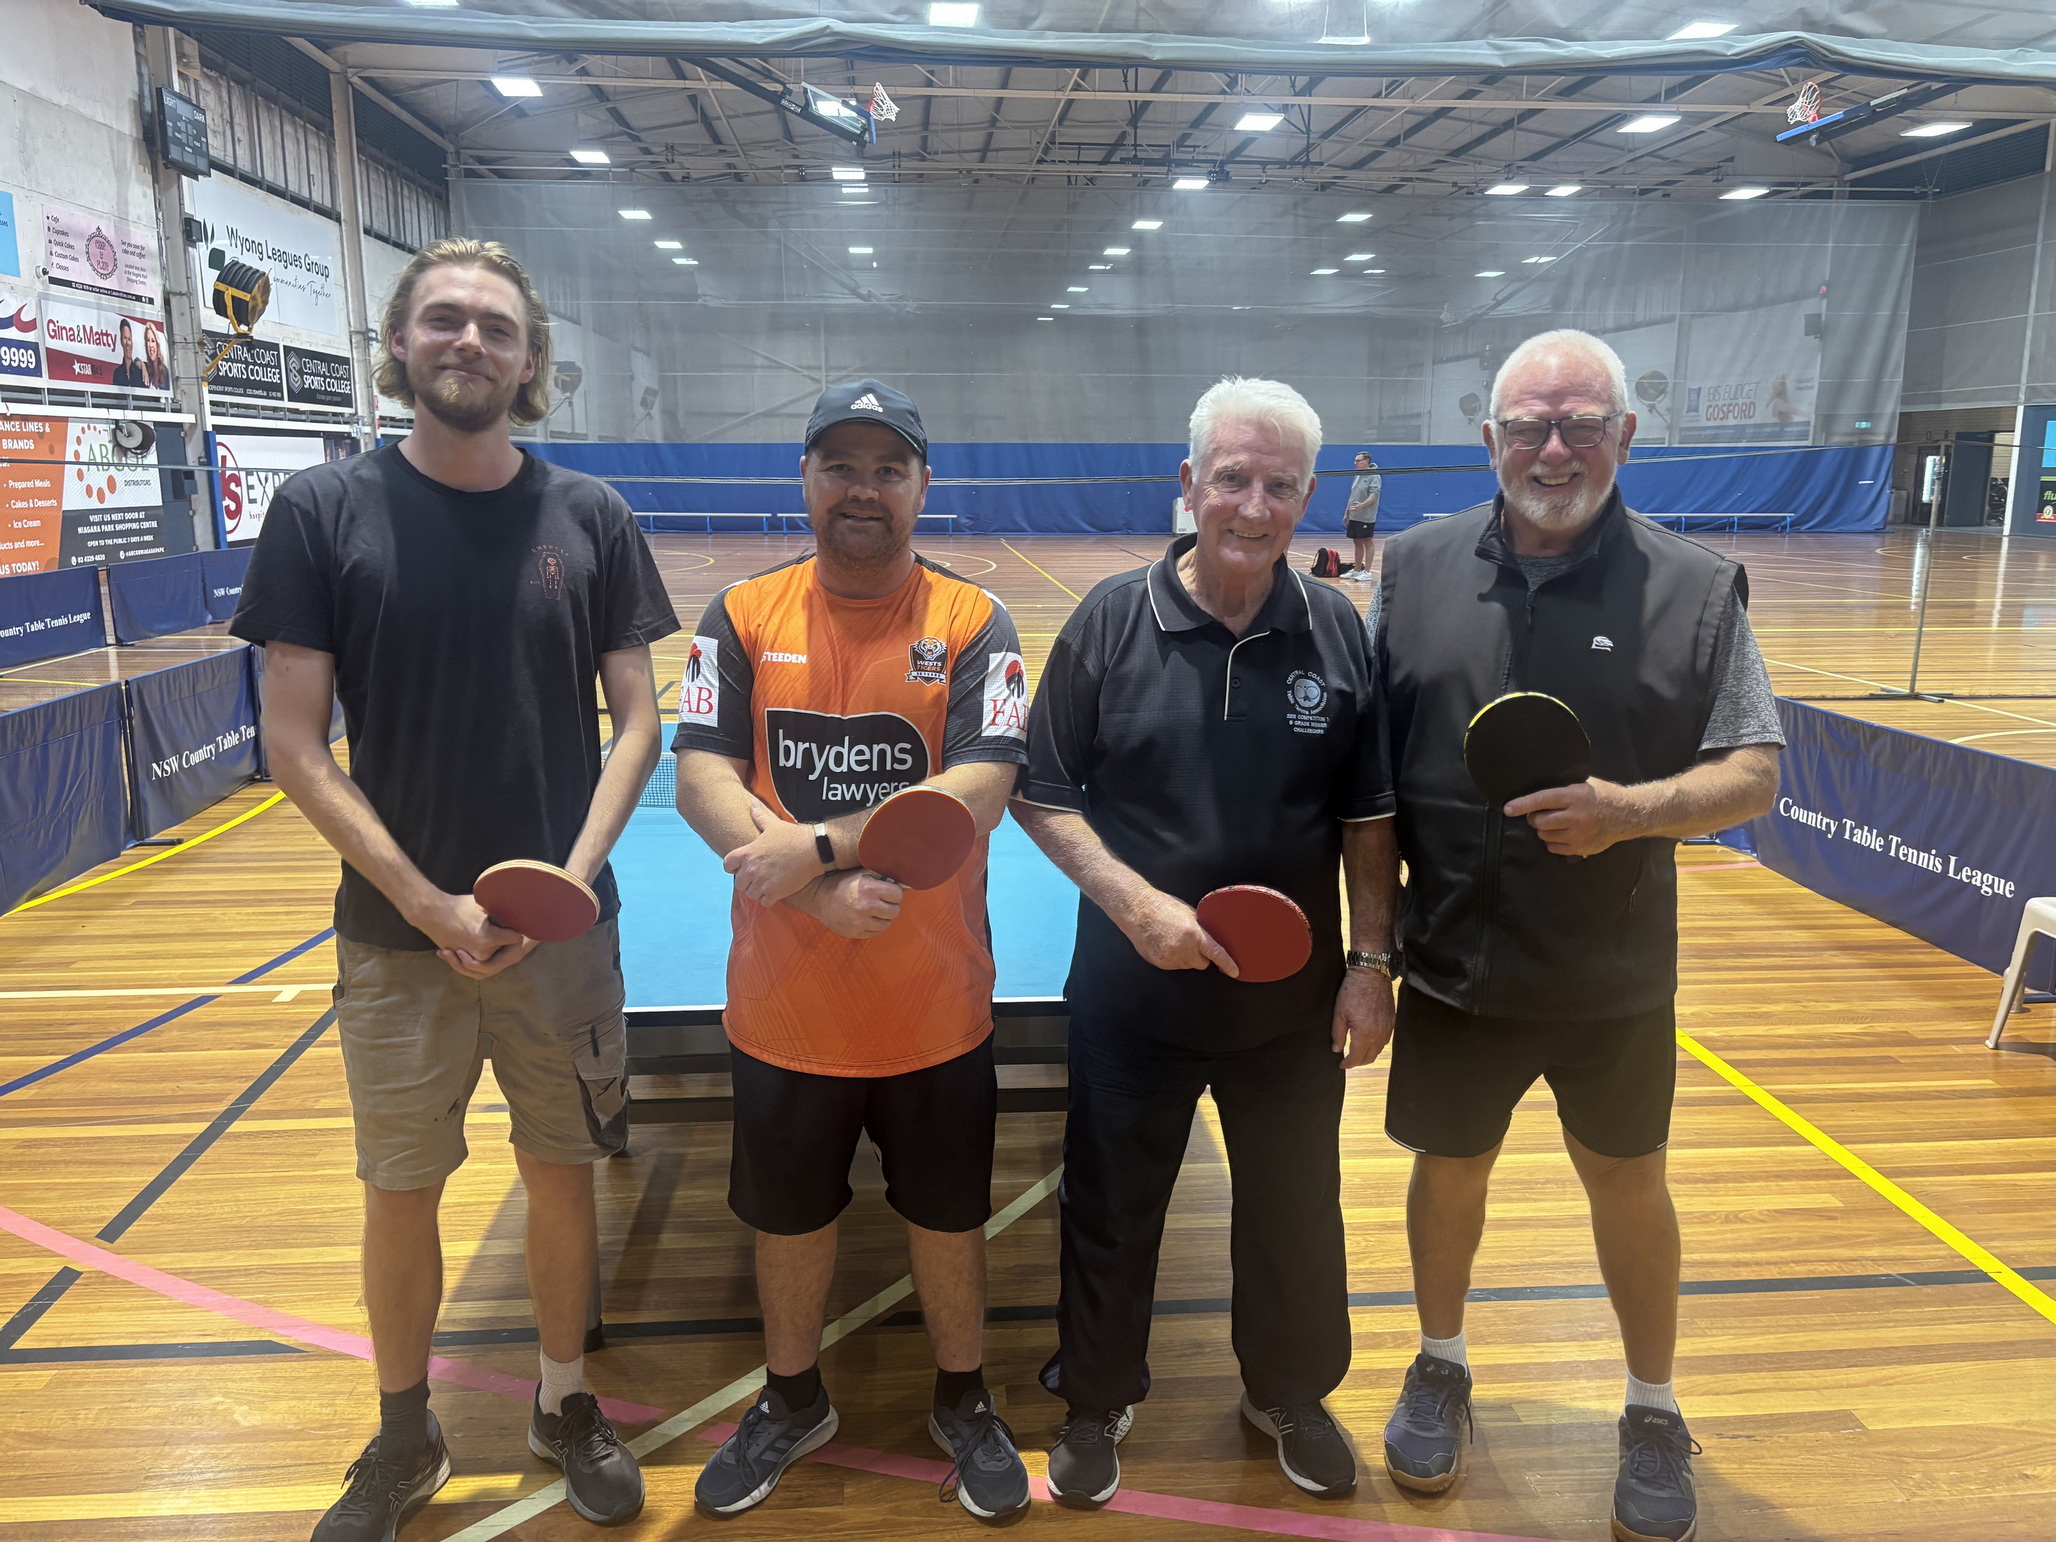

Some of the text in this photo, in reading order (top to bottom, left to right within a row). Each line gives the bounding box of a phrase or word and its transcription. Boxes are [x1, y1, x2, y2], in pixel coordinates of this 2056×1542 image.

[226, 224, 330, 283] Wyong Leagues Group
[47, 318, 117, 352] Gina&Matty
[216, 341, 278, 366] CENTRAL COAST
[218, 362, 281, 384] SPORTS COLLEGE
[301, 358, 350, 379] CENTRAL COAST
[303, 375, 352, 394] SPORTS COLLEGE
[850, 402, 884, 413] adidas
[1705, 401, 1756, 422] GOSFORD
[22, 421, 44, 433] LINES
[45, 422, 51, 432] &
[2, 438, 35, 450] BRANDS
[8, 479, 51, 489] Prepared Meals
[11, 500, 28, 509] Cakes
[34, 499, 58, 508] Desserts
[13, 519, 41, 528] Ice Cream
[89, 511, 145, 523] VISIT US NEXT DOOR AT
[77, 520, 158, 534] NIAGARA PARK SHOPPING CENTRE
[14, 539, 25, 549] and
[11, 560, 40, 574] TODAY!
[0, 611, 91, 638] ountry Table Tennis League
[762, 651, 807, 664] STEEDEN
[1286, 670, 1325, 686] CENTRAL COAST
[679, 686, 714, 715] AB
[151, 725, 257, 781] NSW Country Table Ten
[778, 728, 913, 781] brydens
[1779, 796, 1838, 839] Country
[1842, 818, 1885, 852] Table
[1887, 834, 1943, 874] Tennis
[1947, 855, 2015, 898] League
